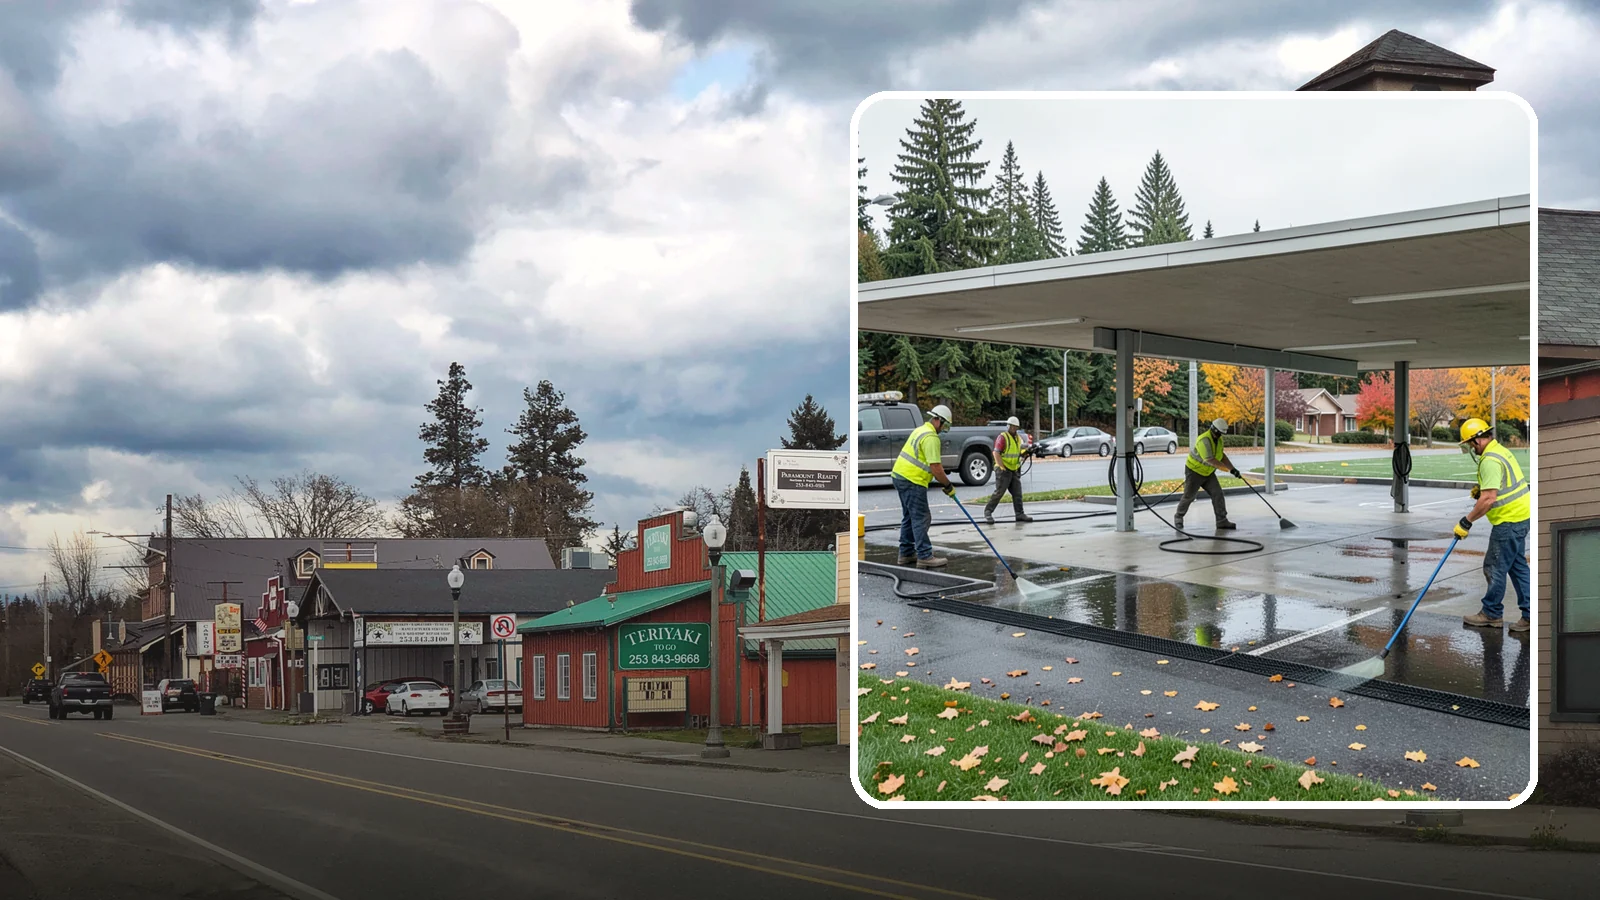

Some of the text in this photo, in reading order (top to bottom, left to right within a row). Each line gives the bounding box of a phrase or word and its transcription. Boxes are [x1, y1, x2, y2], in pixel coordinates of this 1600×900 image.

[781, 471, 815, 479] PARAMOUNT
[646, 531, 668, 549] TERIYAKI
[625, 627, 702, 646] TERIYAKI
[628, 653, 700, 665] 253 843-9668
[639, 680, 673, 691] TERIYAKI
